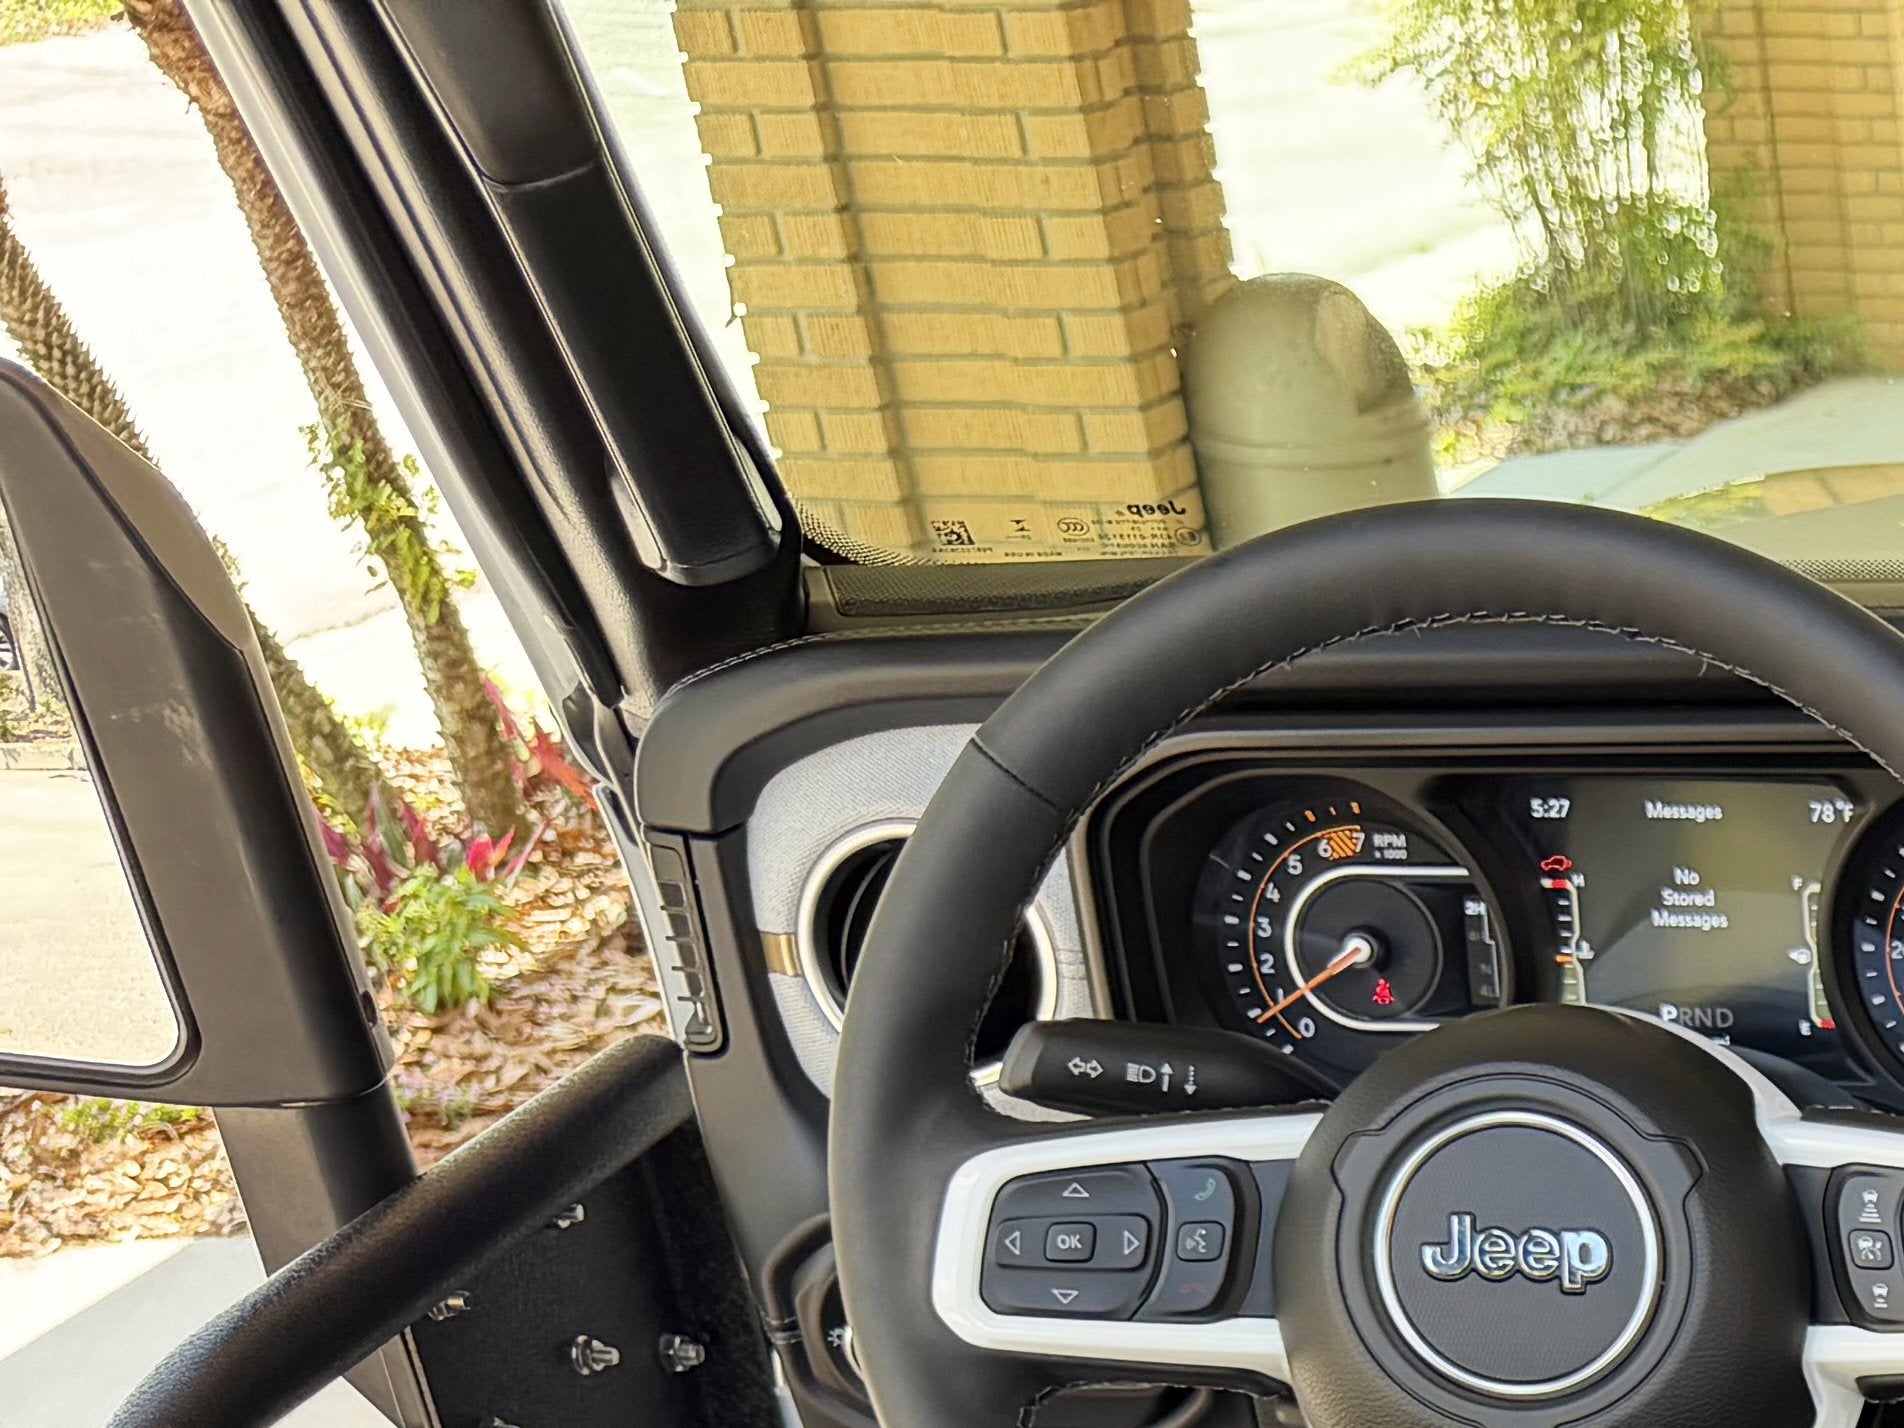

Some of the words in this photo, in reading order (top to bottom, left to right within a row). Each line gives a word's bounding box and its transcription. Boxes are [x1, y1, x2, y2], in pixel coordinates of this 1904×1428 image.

[1530, 799, 1570, 818] 5:27
[1645, 800, 1723, 822] Messages
[1317, 839, 1332, 859] 6
[1373, 834, 1406, 849] RPM
[1286, 856, 1303, 876] 5
[1673, 867, 1700, 886] No
[1265, 882, 1281, 903] 4
[1660, 888, 1715, 907] Stored
[1256, 916, 1272, 937] 3
[1651, 909, 1729, 930] Messages
[1260, 954, 1275, 975] 2
[1298, 1018, 1316, 1039] 0
[1799, 1019, 1812, 1036] E
[1056, 1233, 1083, 1250] OK
[1420, 1211, 1614, 1297] Jeep
